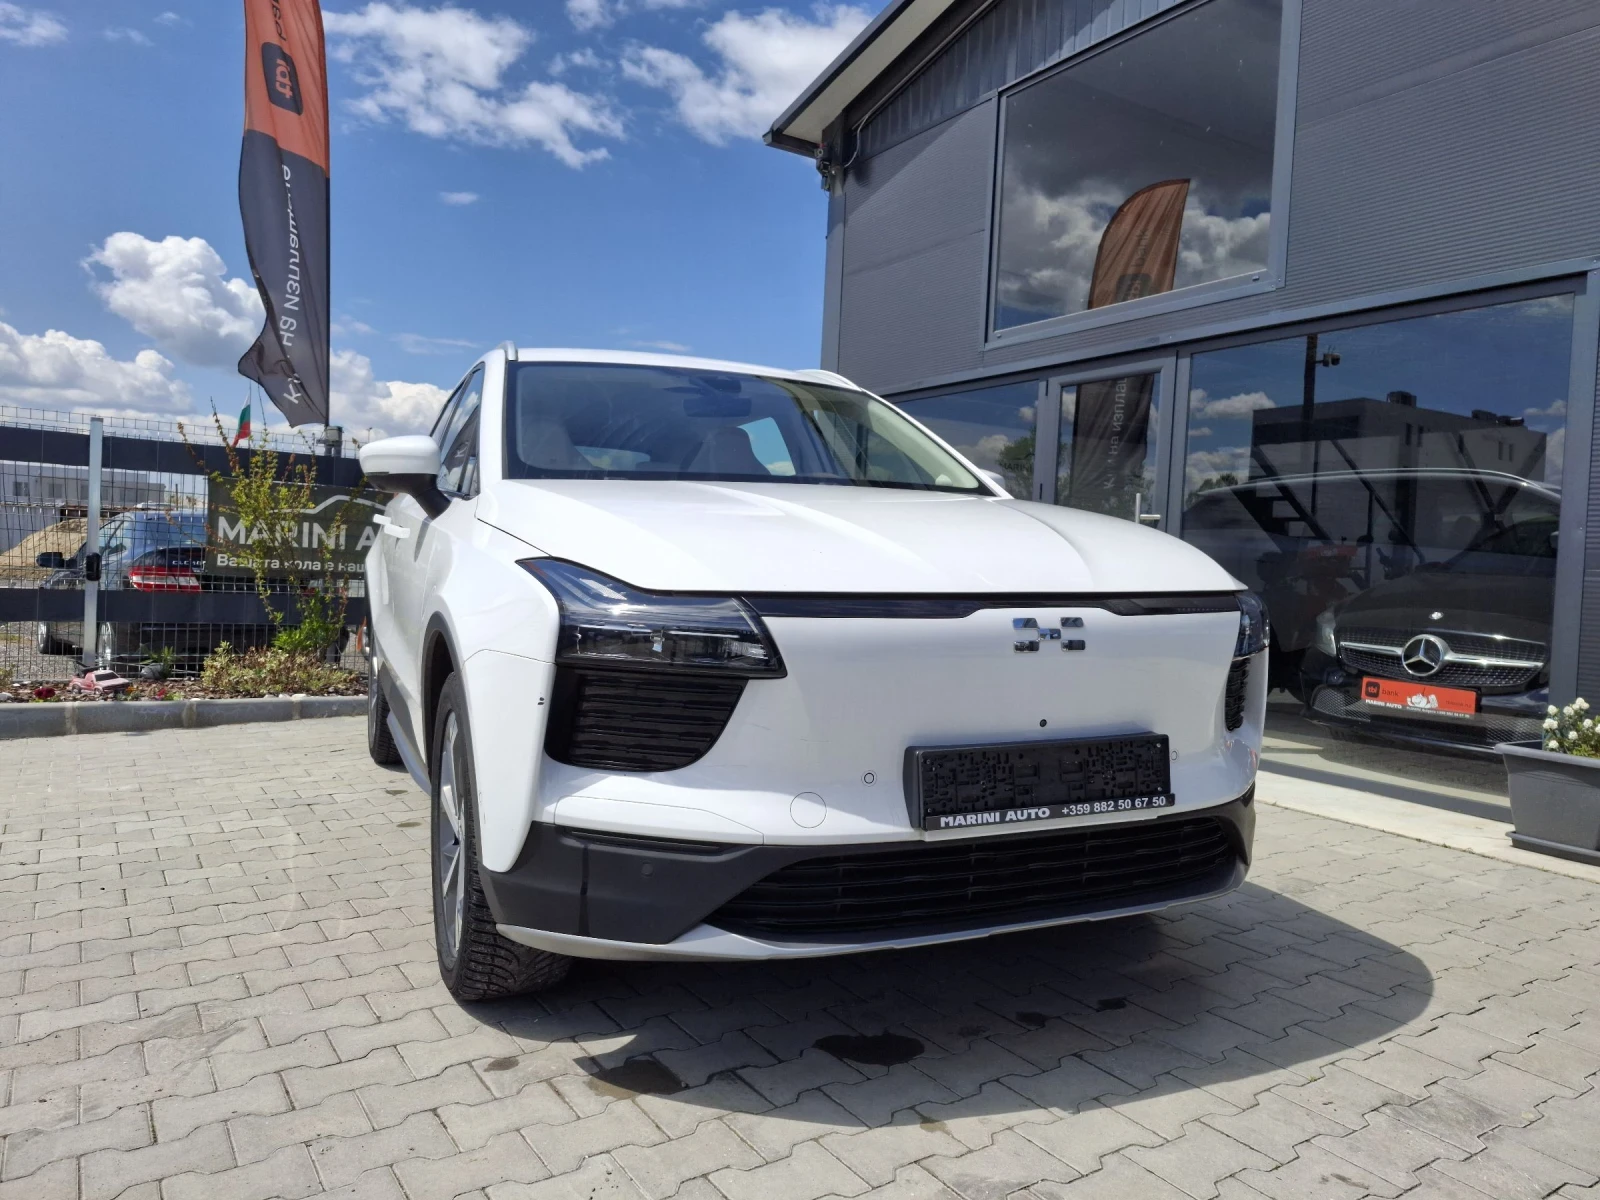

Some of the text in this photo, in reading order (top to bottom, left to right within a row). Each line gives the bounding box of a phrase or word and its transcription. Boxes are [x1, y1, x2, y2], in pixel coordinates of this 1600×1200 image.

[1381, 688, 1400, 697] bank
[940, 796, 1166, 828] MARINI AUTO +359 882 50 67 50
